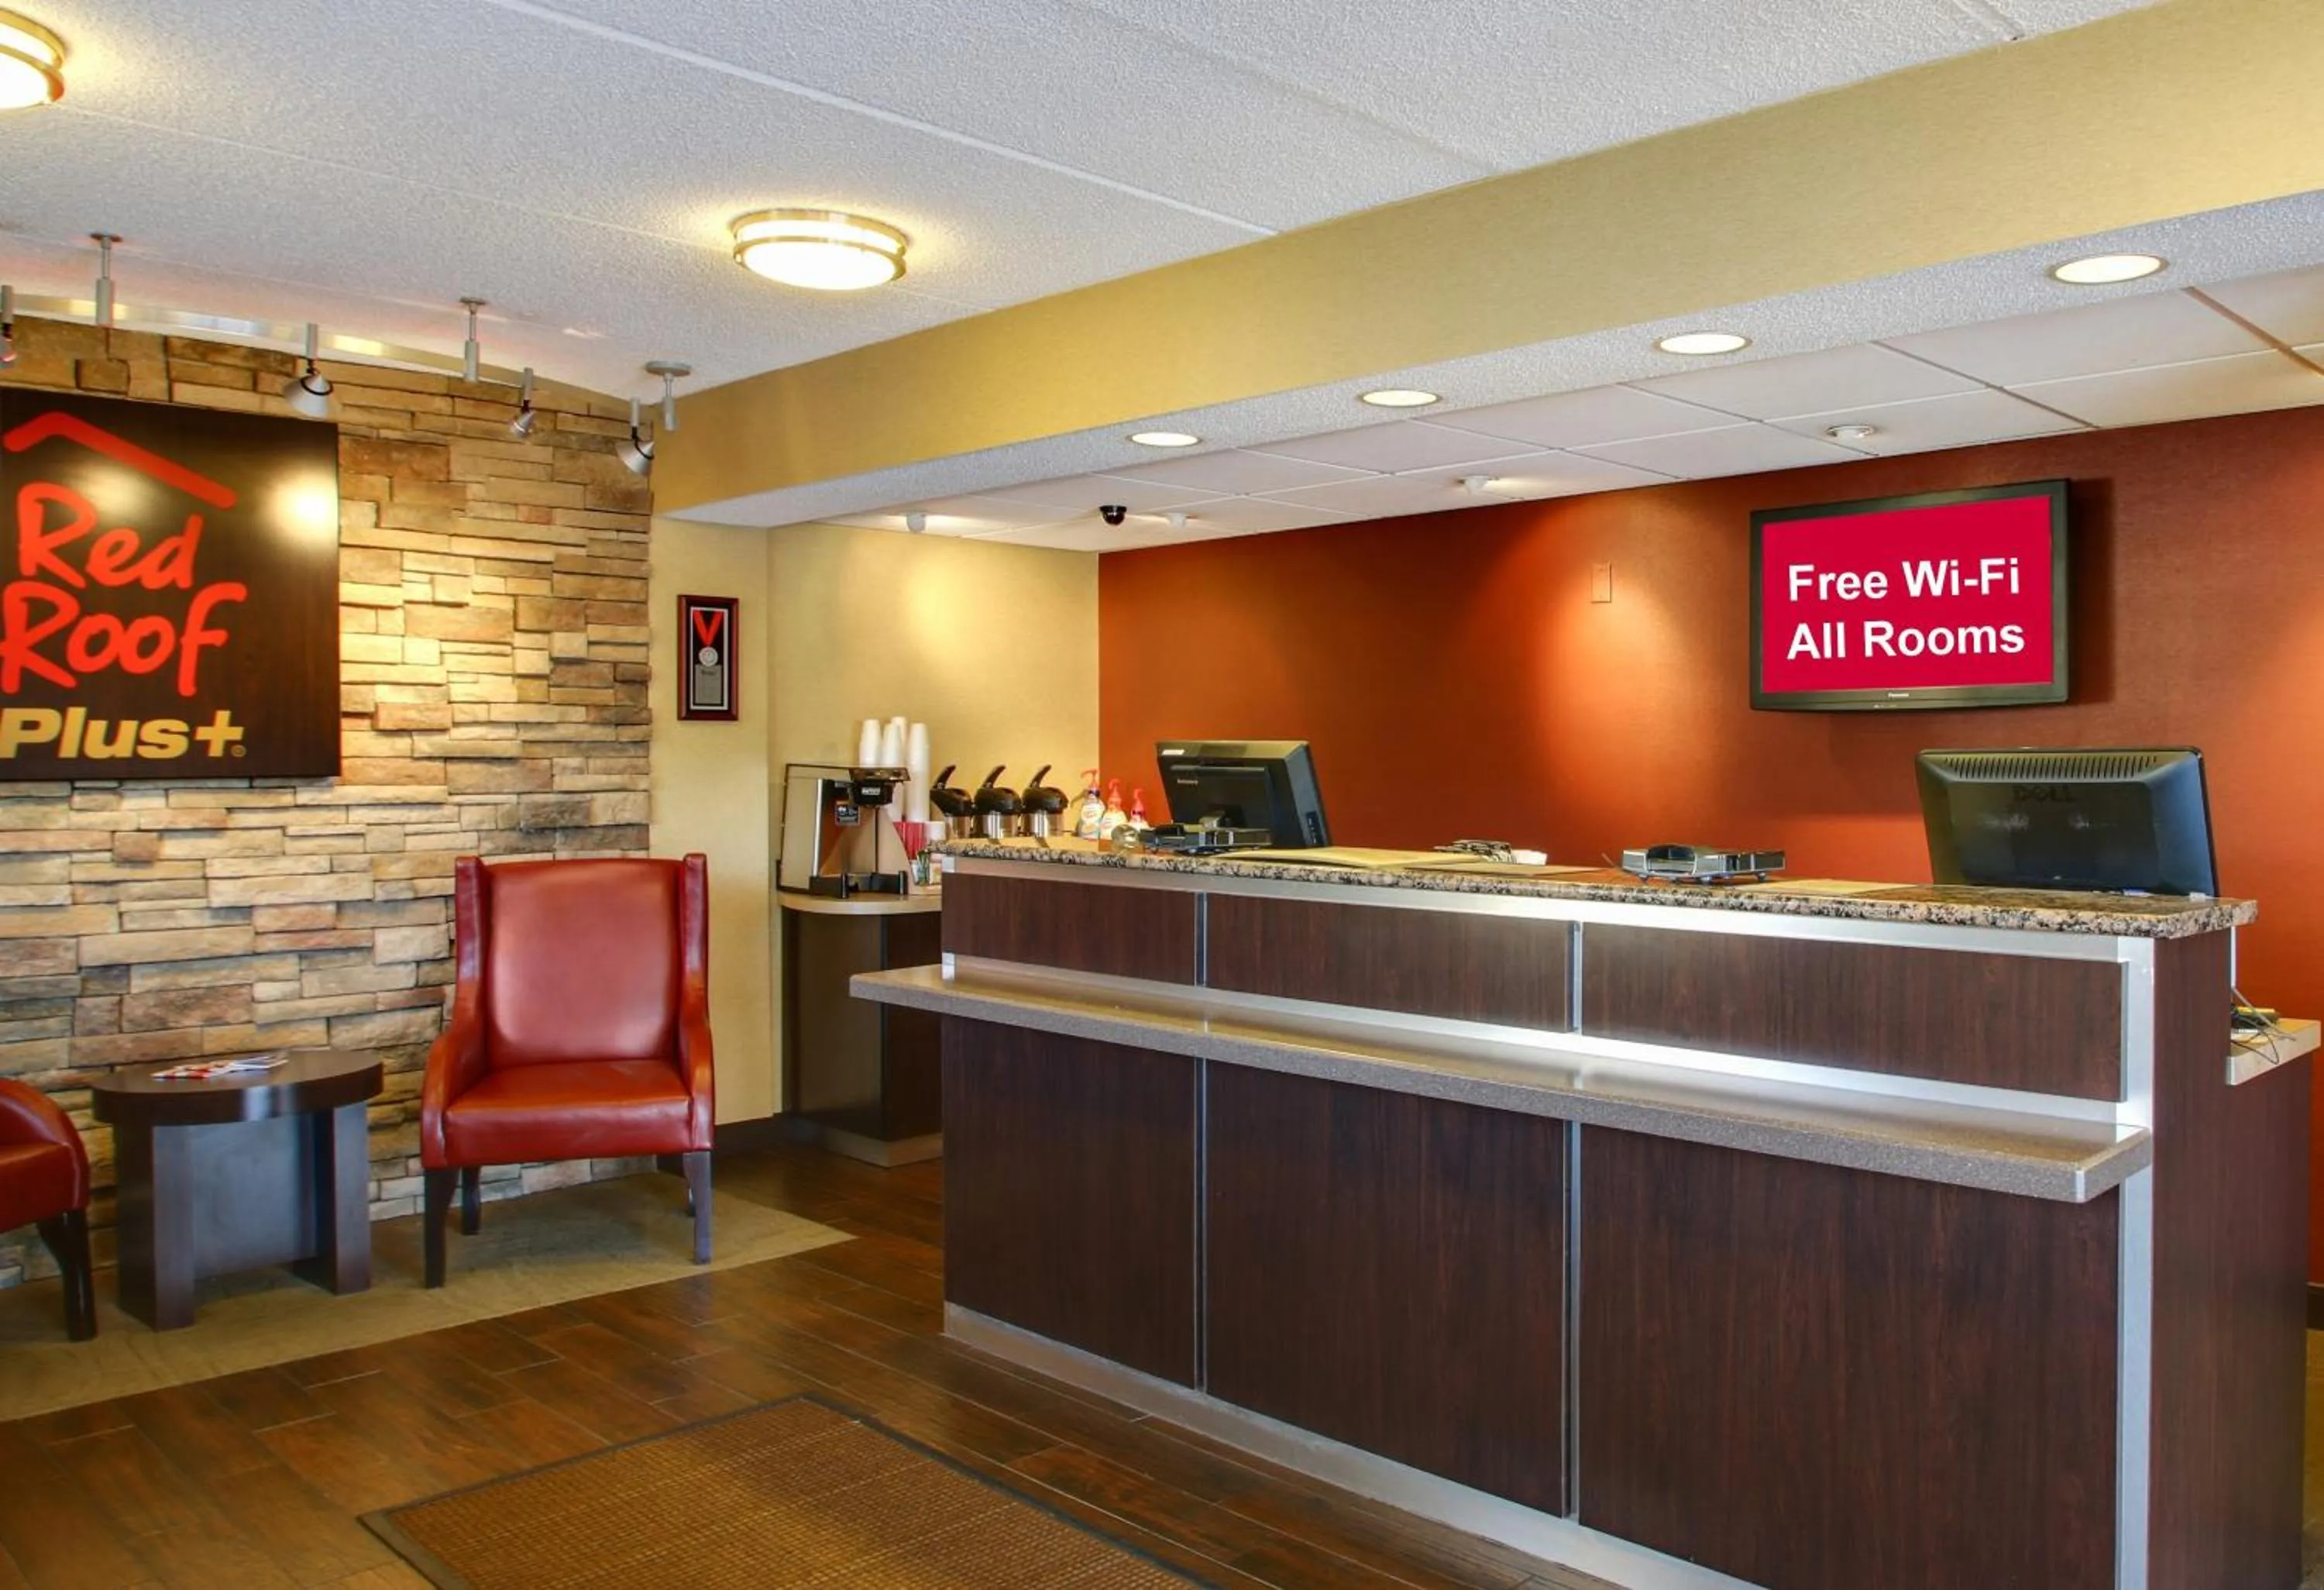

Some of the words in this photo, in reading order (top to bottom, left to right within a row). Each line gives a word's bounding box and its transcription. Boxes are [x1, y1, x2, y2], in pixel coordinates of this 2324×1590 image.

[16, 481, 203, 589] Red
[1788, 563, 1889, 602] Free
[1901, 557, 2020, 597] Wi-Fi
[0, 580, 247, 697] Roof
[1786, 621, 1847, 660] All
[1863, 619, 2026, 658] Rooms
[2012, 783, 2078, 803] DELL
